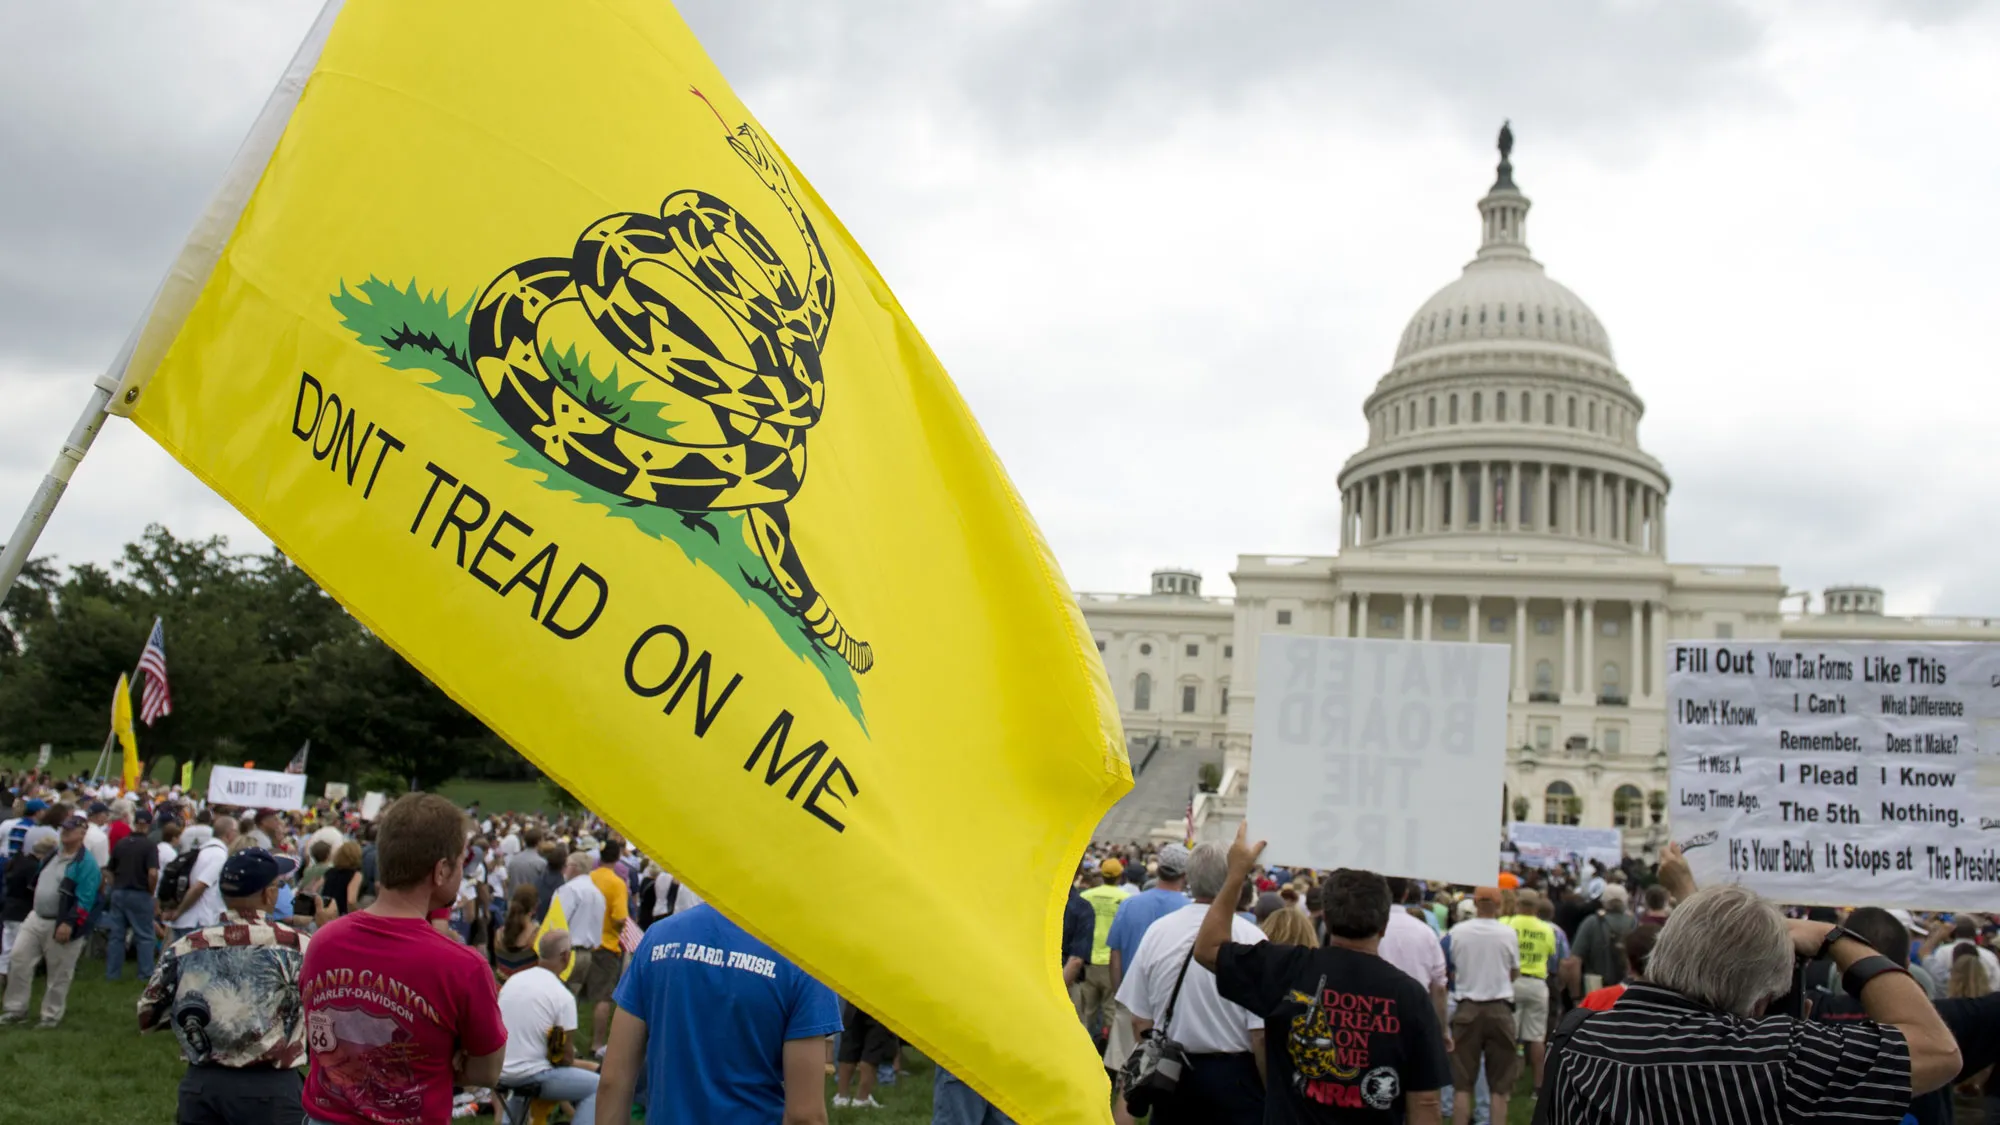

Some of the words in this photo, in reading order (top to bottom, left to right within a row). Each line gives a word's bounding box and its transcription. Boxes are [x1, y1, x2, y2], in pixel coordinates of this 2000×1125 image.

[292, 371, 406, 500] DONT
[410, 462, 609, 640] TREAD
[623, 624, 744, 738] ON
[743, 708, 860, 834] ME
[1676, 647, 1708, 673] Fill
[1716, 648, 1754, 675] Out
[1767, 652, 1793, 679] Your
[1795, 653, 1815, 680] Tax
[1819, 654, 1853, 681] Forms
[1864, 657, 1901, 683] Like
[1907, 658, 1947, 685] This
[1678, 699, 1683, 724] I
[1686, 699, 1718, 725] Don't
[1721, 700, 1757, 726] Know.
[1794, 693, 1799, 713] I
[1808, 694, 1846, 714] Can't
[1882, 695, 1908, 715] What
[1910, 695, 1964, 717] Difference
[1780, 731, 1862, 752] Remember.
[1886, 733, 1912, 753] Does
[1925, 734, 1958, 755] Make?
[1709, 756, 1732, 774] Was
[1734, 756, 1742, 774] A
[1780, 764, 1785, 783] I
[1800, 764, 1859, 786] Plead
[1881, 767, 1887, 785] I
[1900, 767, 1956, 788] Know
[1681, 789, 1706, 811] Long
[1709, 789, 1735, 808] Time
[1737, 790, 1761, 813] Ago.
[1779, 801, 1819, 822] The
[1826, 803, 1861, 824] 5th
[1881, 802, 1965, 828] Nothing.
[1729, 838, 1749, 872] It's
[1752, 839, 1780, 873] Your
[1783, 841, 1815, 874] Buck
[1826, 843, 1838, 869] It
[1843, 844, 1891, 876] Stops
[1896, 845, 1913, 871] at
[1926, 846, 1951, 880] The
[683, 942, 725, 968] HARD,
[727, 951, 777, 979] FINISH.
[313, 987, 414, 1023] HARLEY-DAVIDSON
[359, 969, 440, 1025] CANYON
[1323, 988, 1397, 1015] DON'T
[1325, 1008, 1400, 1034] TREAD
[311, 1030, 328, 1047] 66
[1335, 1029, 1371, 1049] ON
[1336, 1047, 1370, 1068] ME
[1306, 1079, 1364, 1108] NRA
